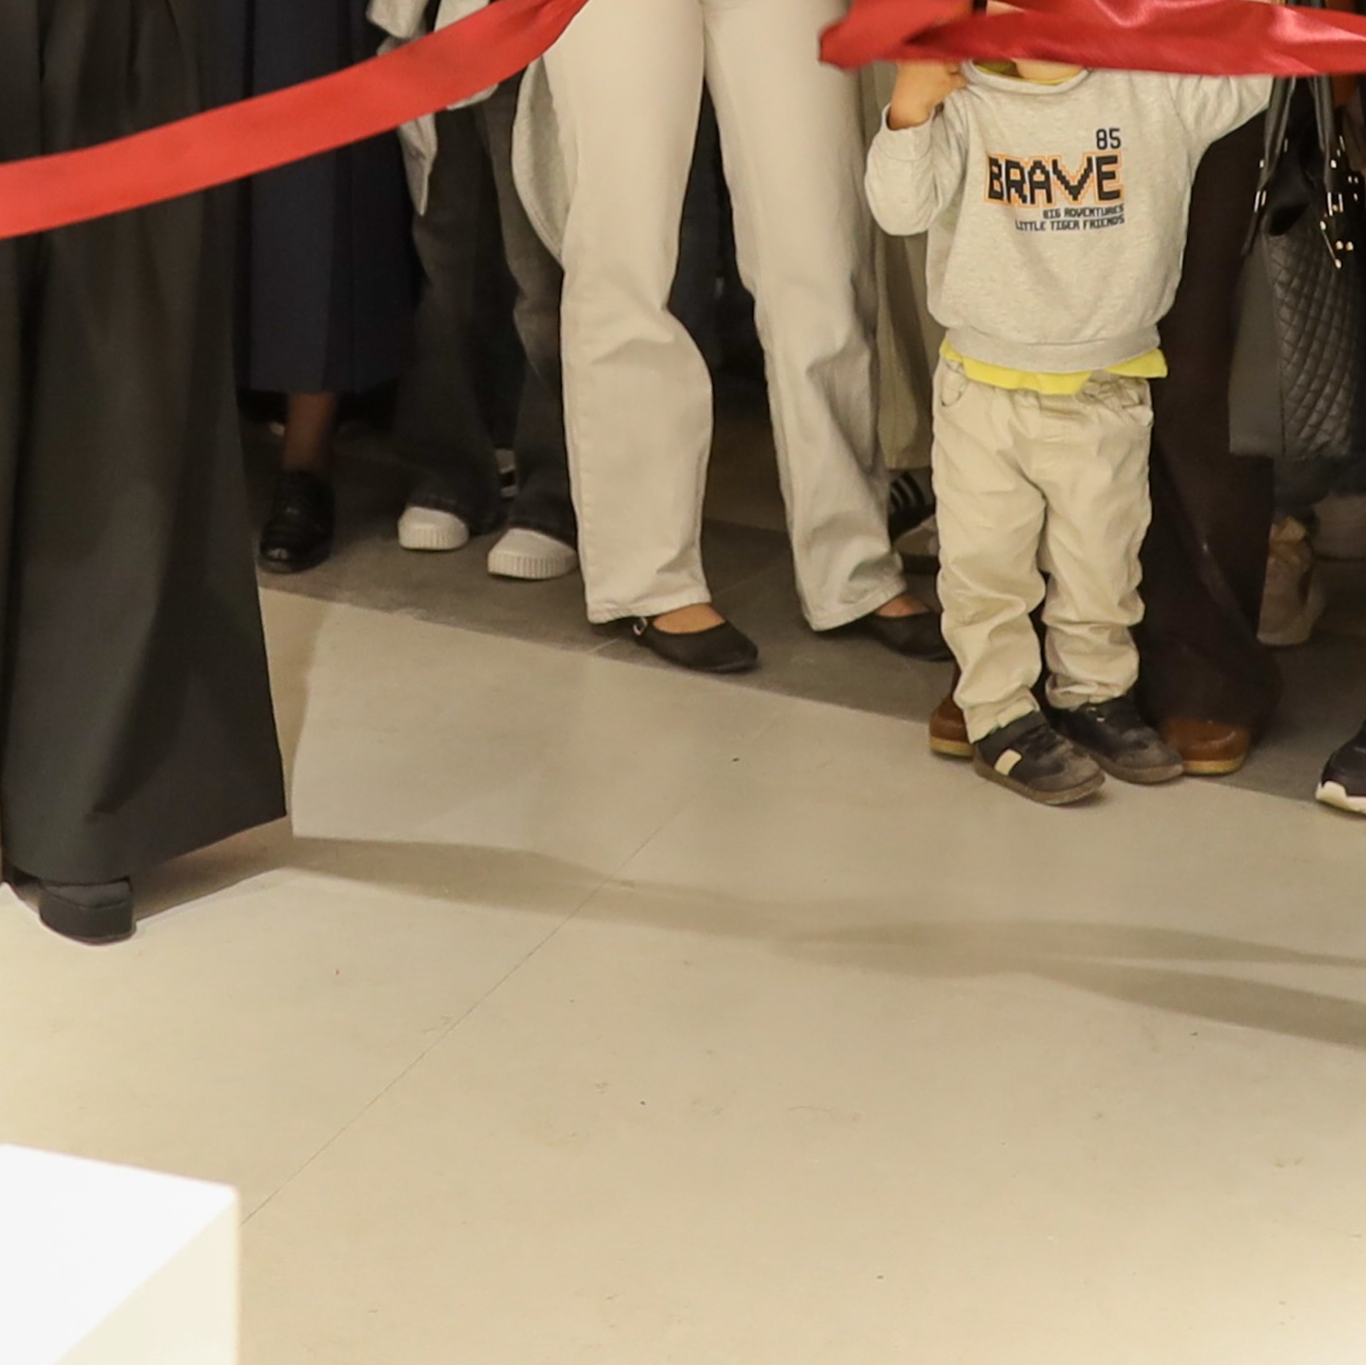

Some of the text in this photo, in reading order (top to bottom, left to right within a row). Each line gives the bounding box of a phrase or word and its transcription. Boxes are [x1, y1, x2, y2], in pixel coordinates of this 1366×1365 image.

[1095, 128, 1122, 150] 85
[987, 153, 1122, 205] BRAVE
[1043, 203, 1124, 219] BIG ADVENTURES
[1015, 214, 1125, 231] LITTLE TIGER FRIENDS
